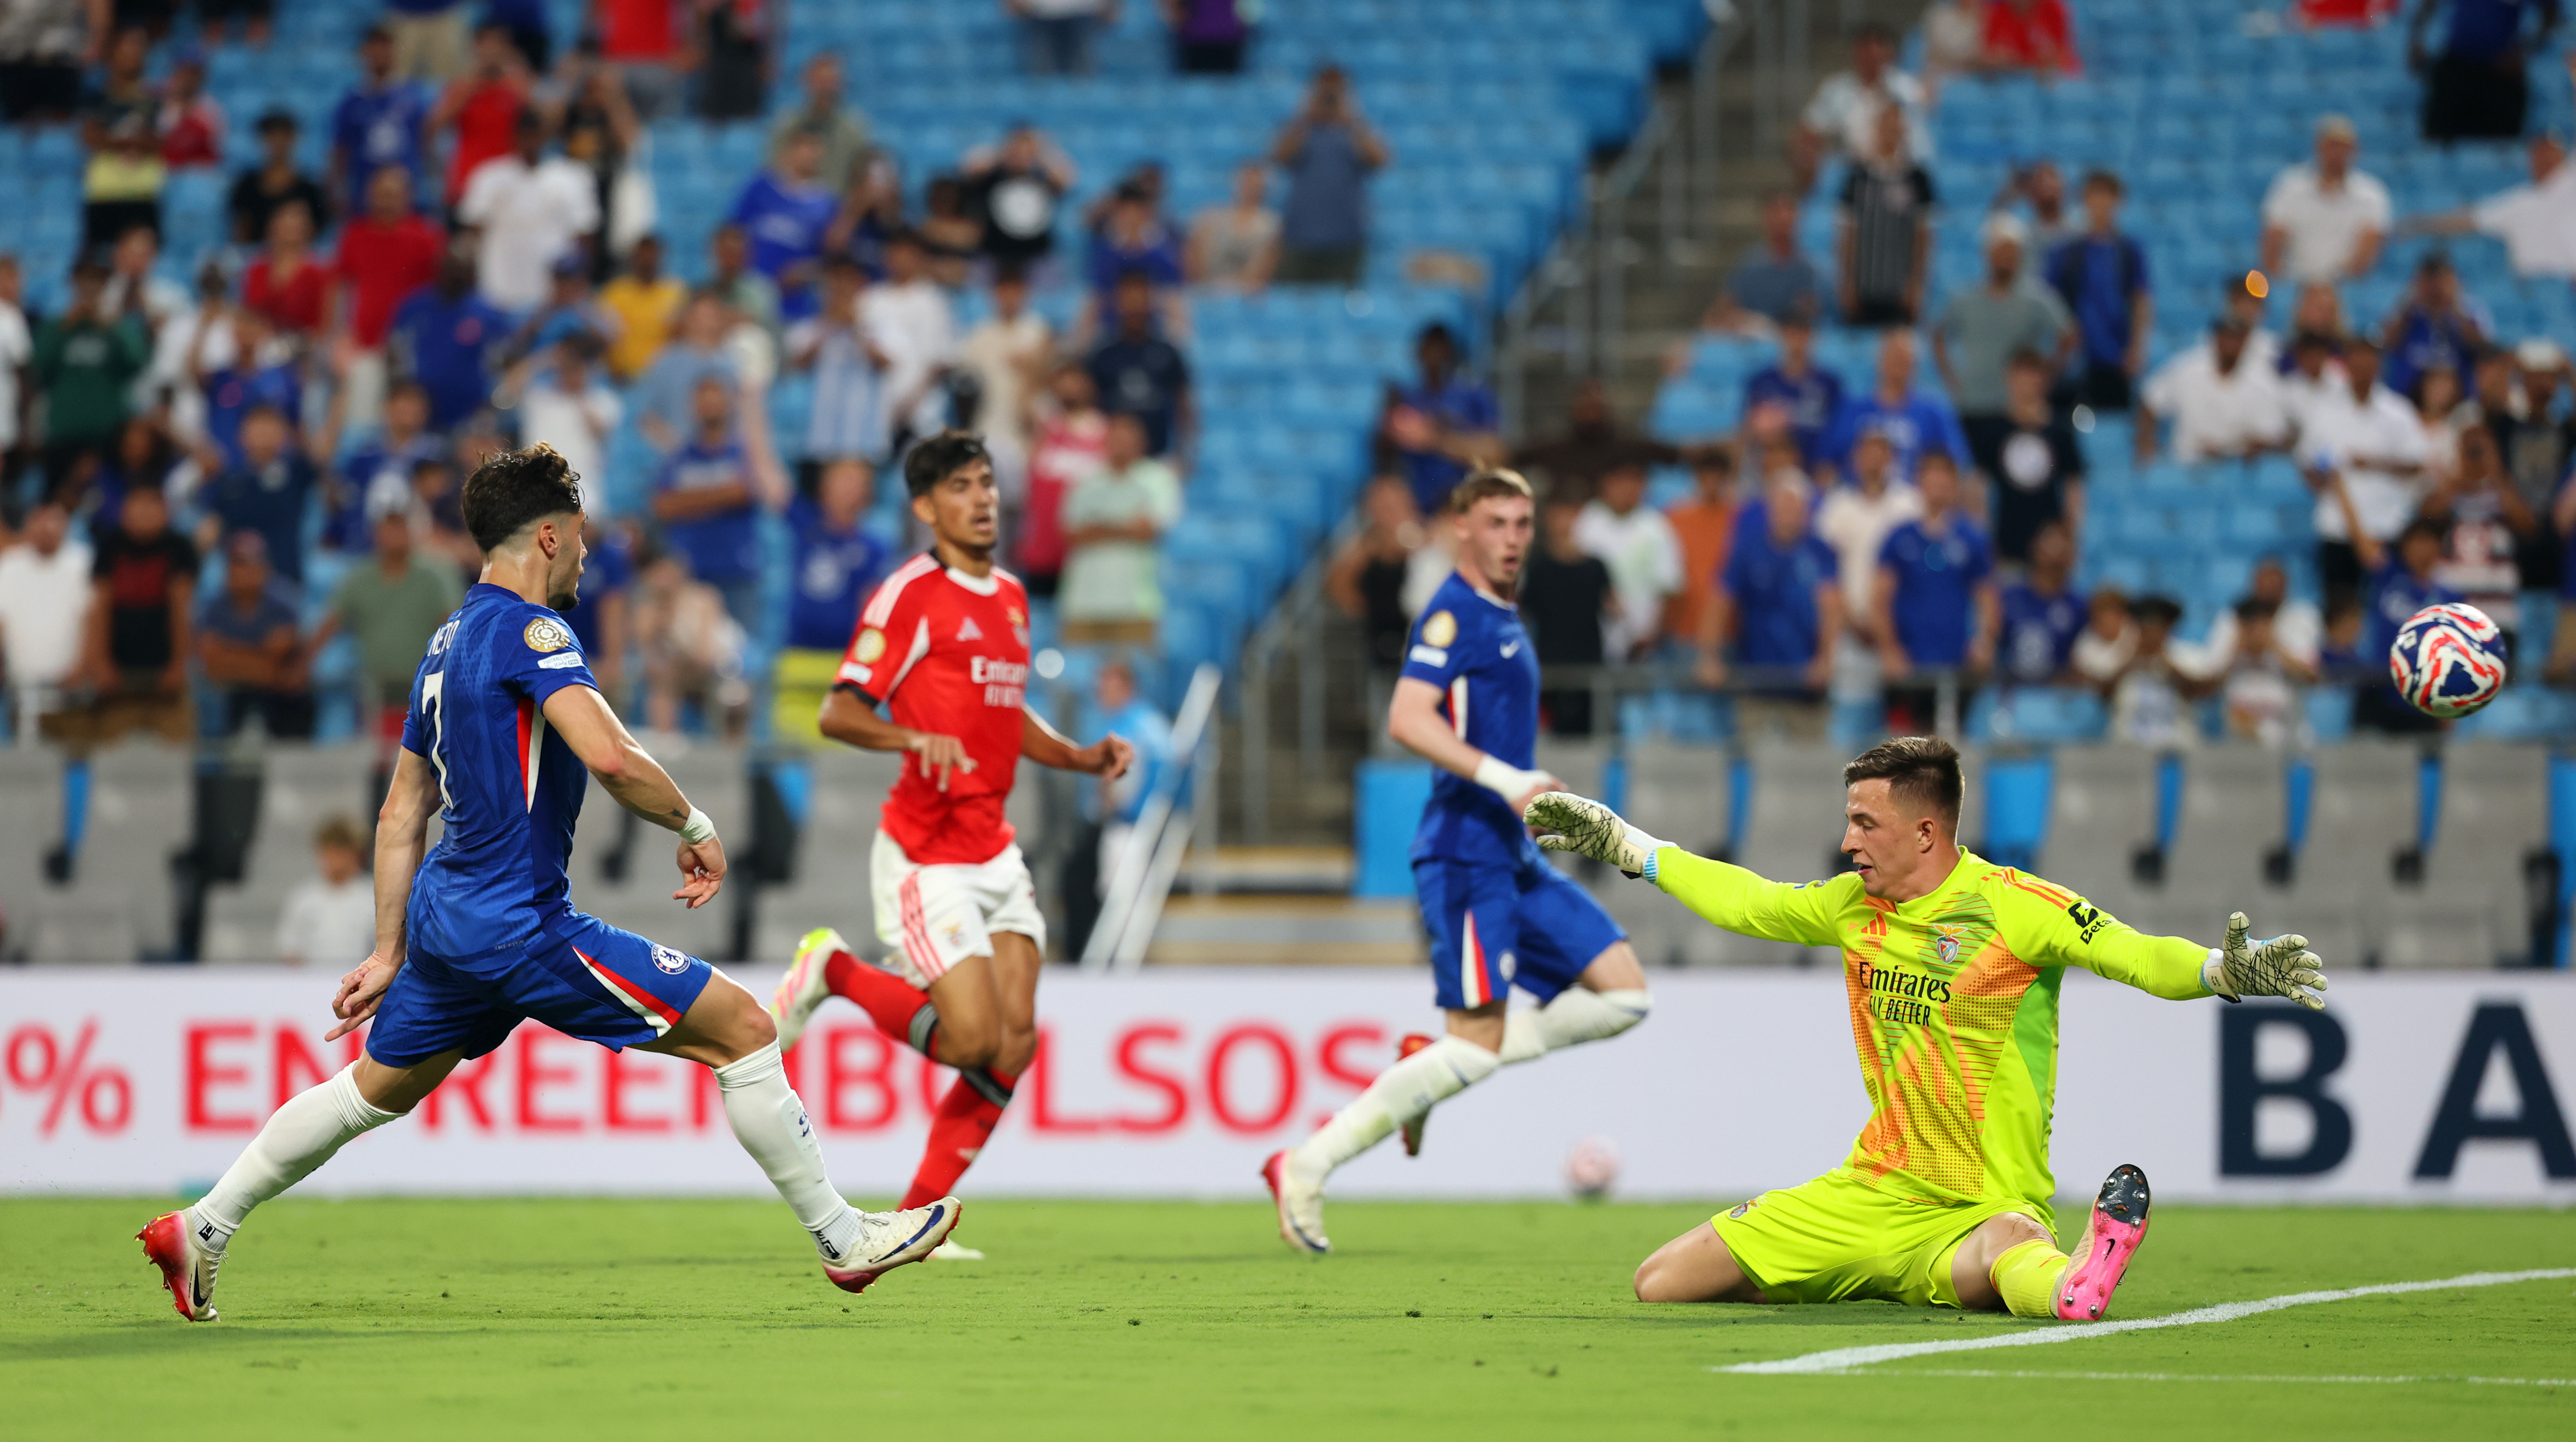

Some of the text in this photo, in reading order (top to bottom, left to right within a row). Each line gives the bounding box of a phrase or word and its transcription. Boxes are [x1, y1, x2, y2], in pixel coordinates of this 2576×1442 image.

[427, 620, 460, 657] NETO
[528, 621, 543, 636] WORLD
[544, 641, 562, 649] FIFA
[422, 670, 453, 809] 7
[1860, 962, 1951, 1003] Emirates
[1869, 996, 1930, 1026] FLY BETTER
